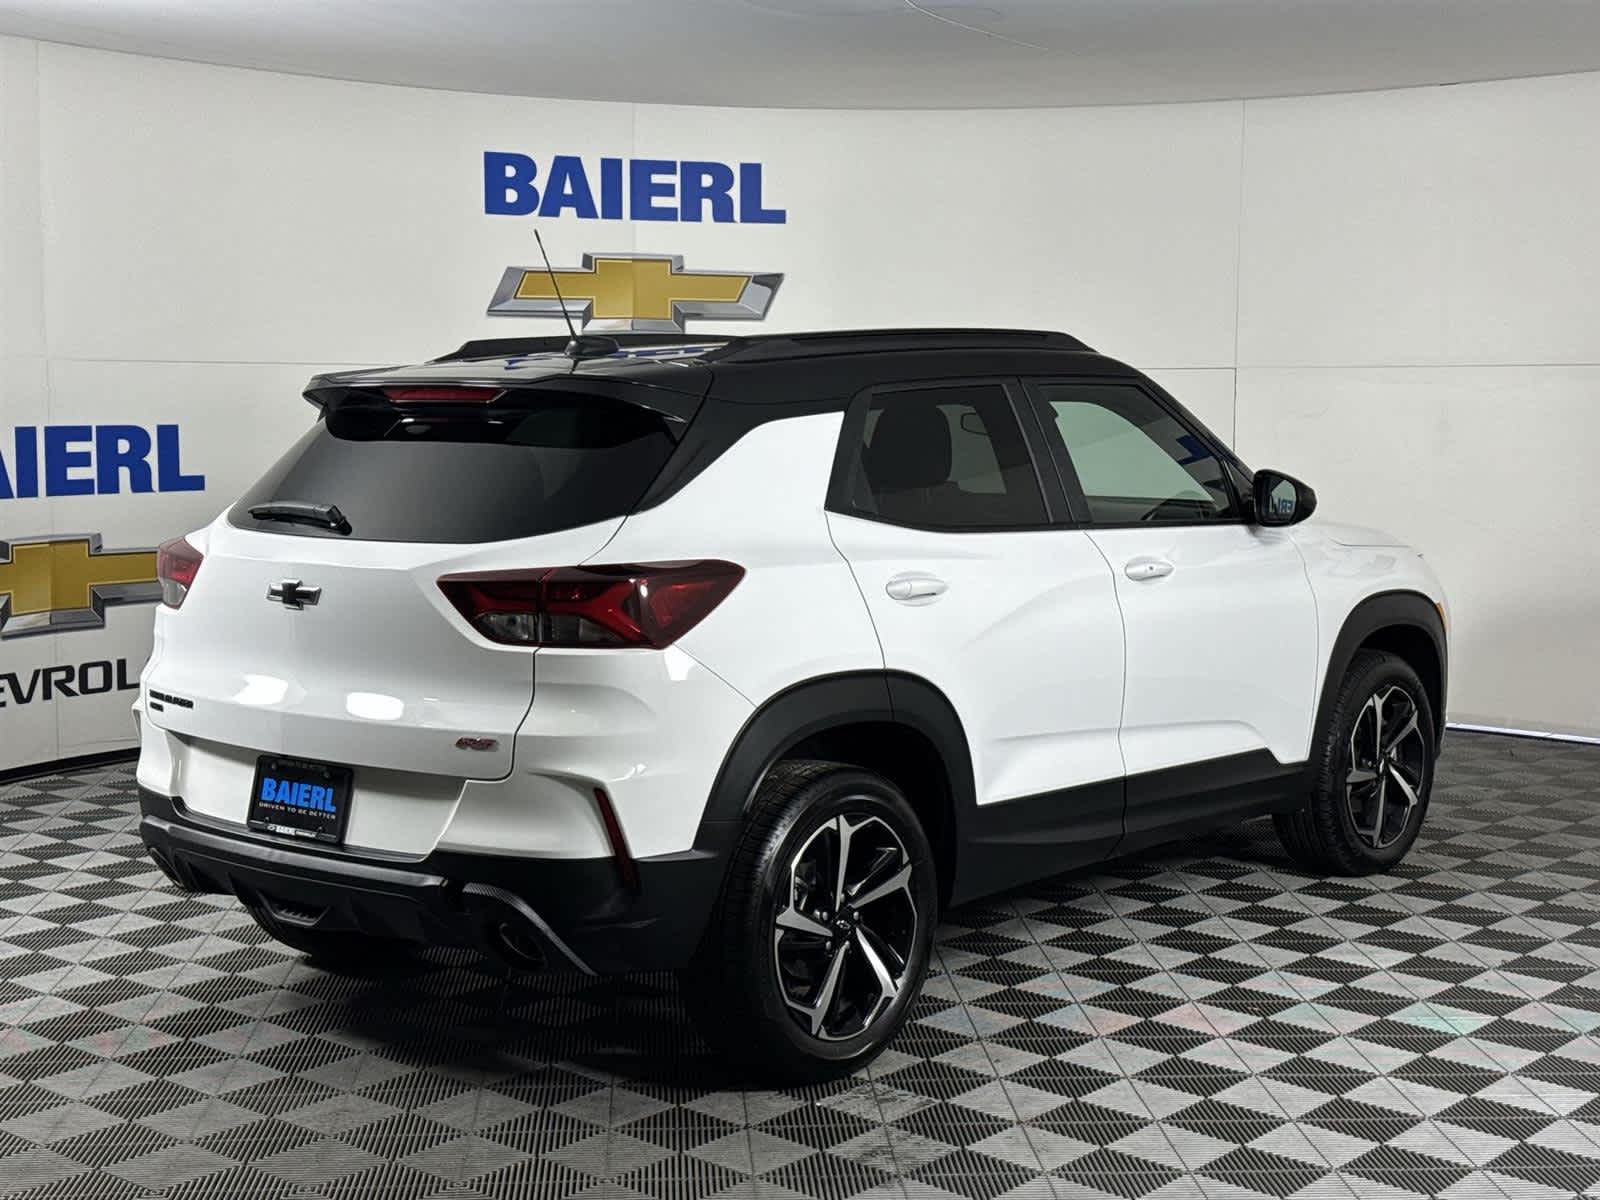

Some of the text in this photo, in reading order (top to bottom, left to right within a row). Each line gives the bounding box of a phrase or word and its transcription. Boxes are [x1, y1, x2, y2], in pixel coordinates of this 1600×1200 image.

[483, 151, 787, 224] BAIERL
[0, 658, 140, 708] VROL
[258, 801, 286, 811] DRIVEN
[287, 806, 297, 814] TO
[308, 810, 337, 820] BETTER
[260, 777, 337, 814] BAIERL
